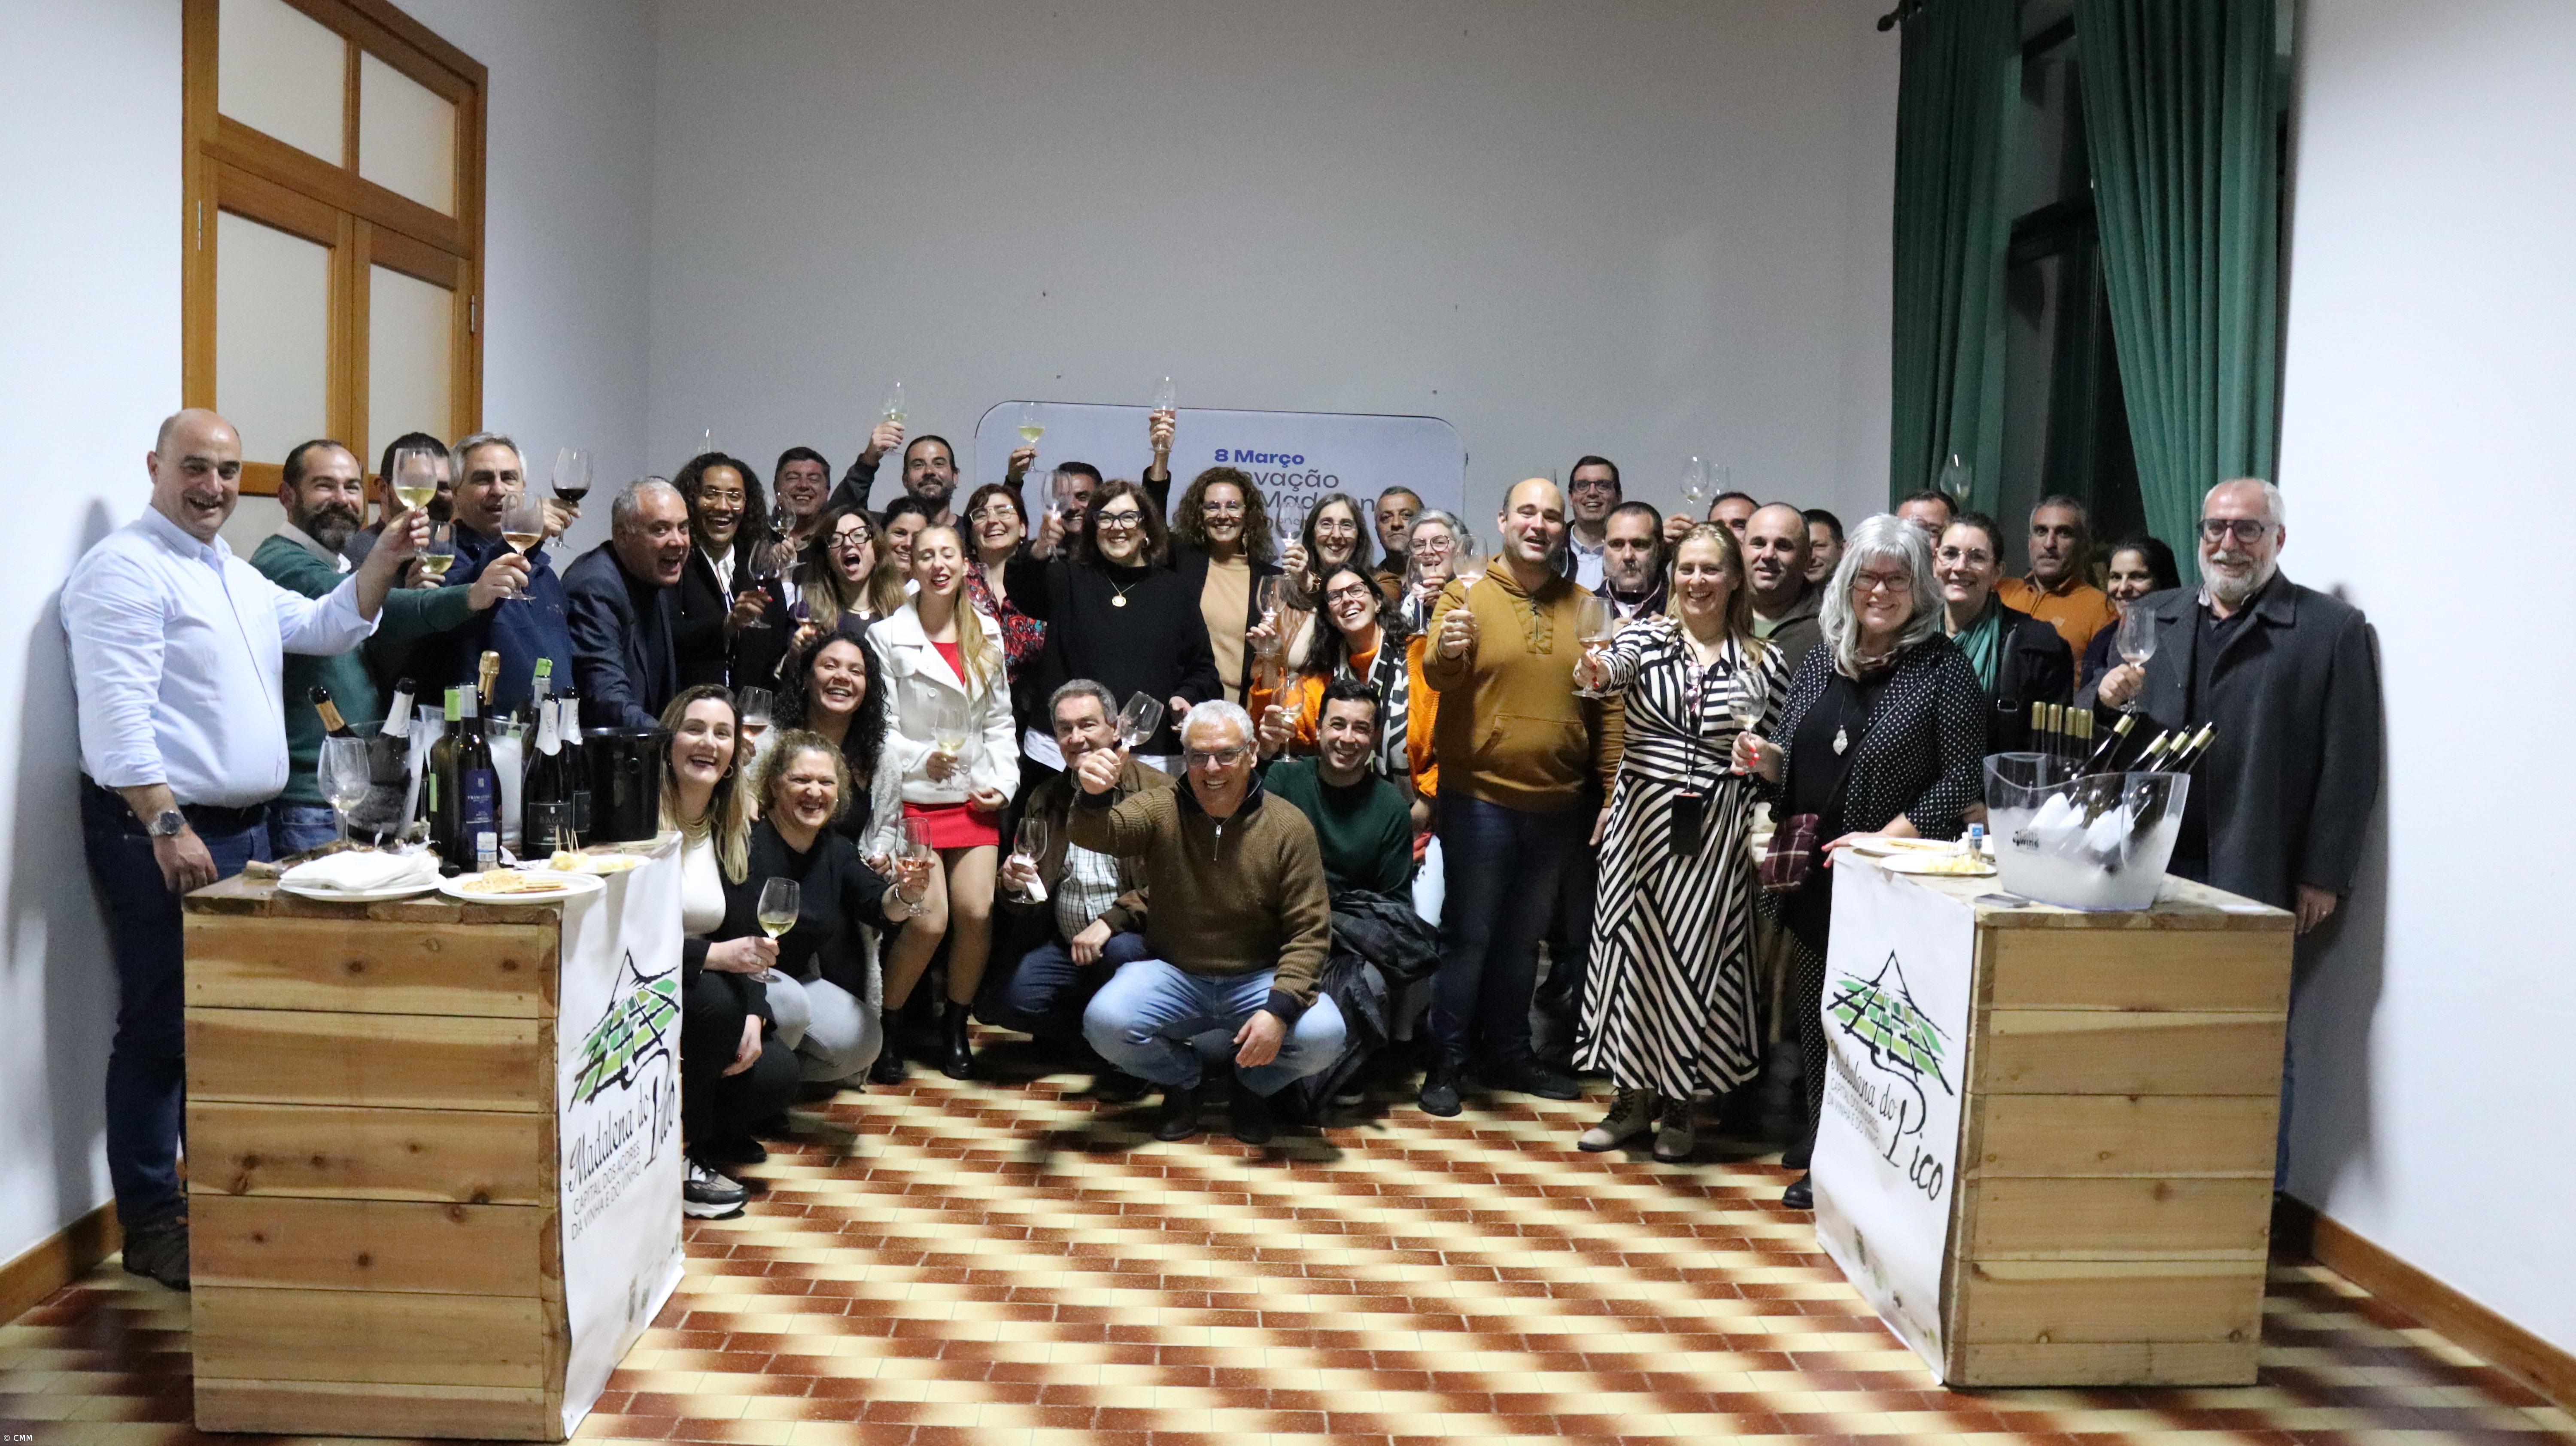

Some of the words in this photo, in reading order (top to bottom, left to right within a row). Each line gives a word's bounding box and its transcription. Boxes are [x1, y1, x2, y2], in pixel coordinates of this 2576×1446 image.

[1214, 449, 1229, 462] 8
[1234, 450, 1305, 468] Março
[1880, 1083, 1897, 1120] do
[1880, 1060, 1943, 1201] Pico
[569, 1109, 633, 1192] Madalena
[638, 1083, 650, 1128] do
[571, 1219, 583, 1240] DA
[584, 1197, 605, 1228] VINHA
[605, 1191, 610, 1207] E
[611, 1181, 621, 1202] DO
[621, 1160, 641, 1190] VINHO
[574, 1179, 601, 1215] CAPITAL
[602, 1163, 616, 1189] DOS
